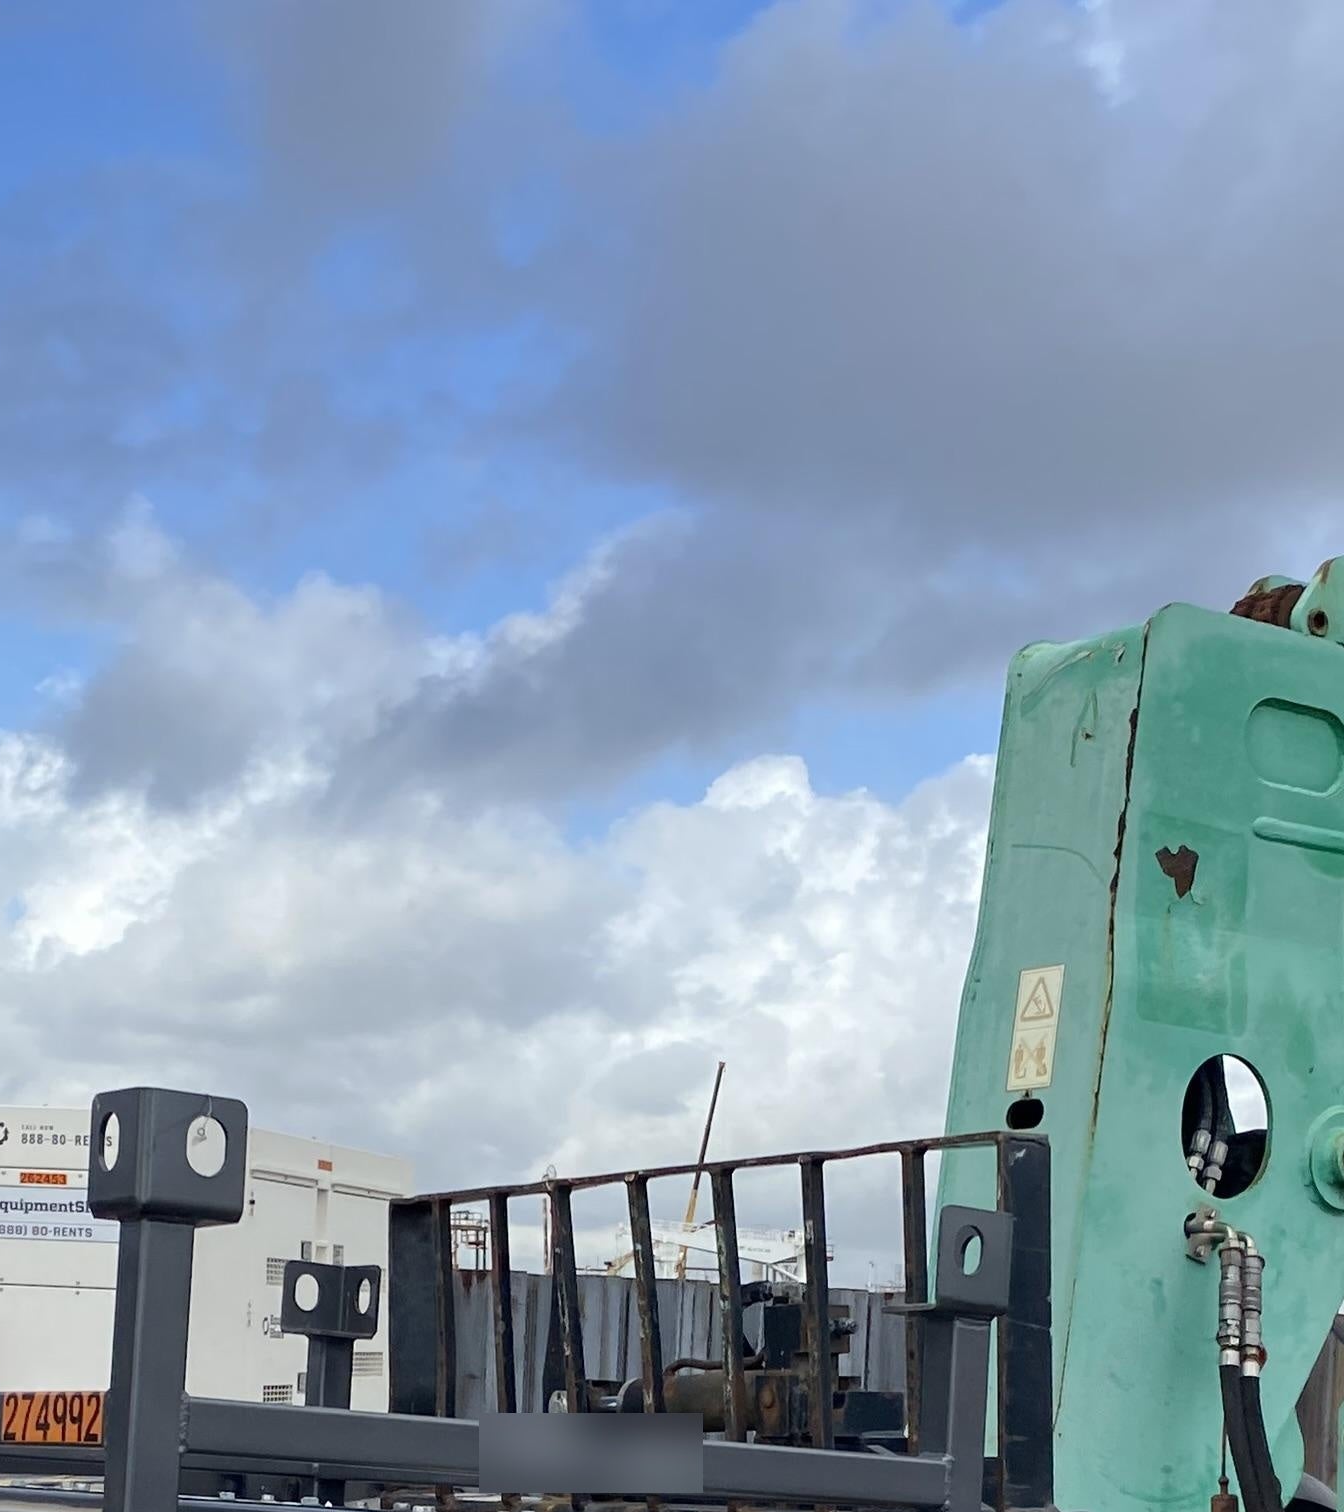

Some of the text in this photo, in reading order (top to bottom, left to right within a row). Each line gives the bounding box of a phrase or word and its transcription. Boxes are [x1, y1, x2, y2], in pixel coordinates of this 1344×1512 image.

[21, 1133, 113, 1147] 888-80-RES
[32, 1226, 93, 1238] 80-RENTS
[3, 1391, 101, 1442] 274992
